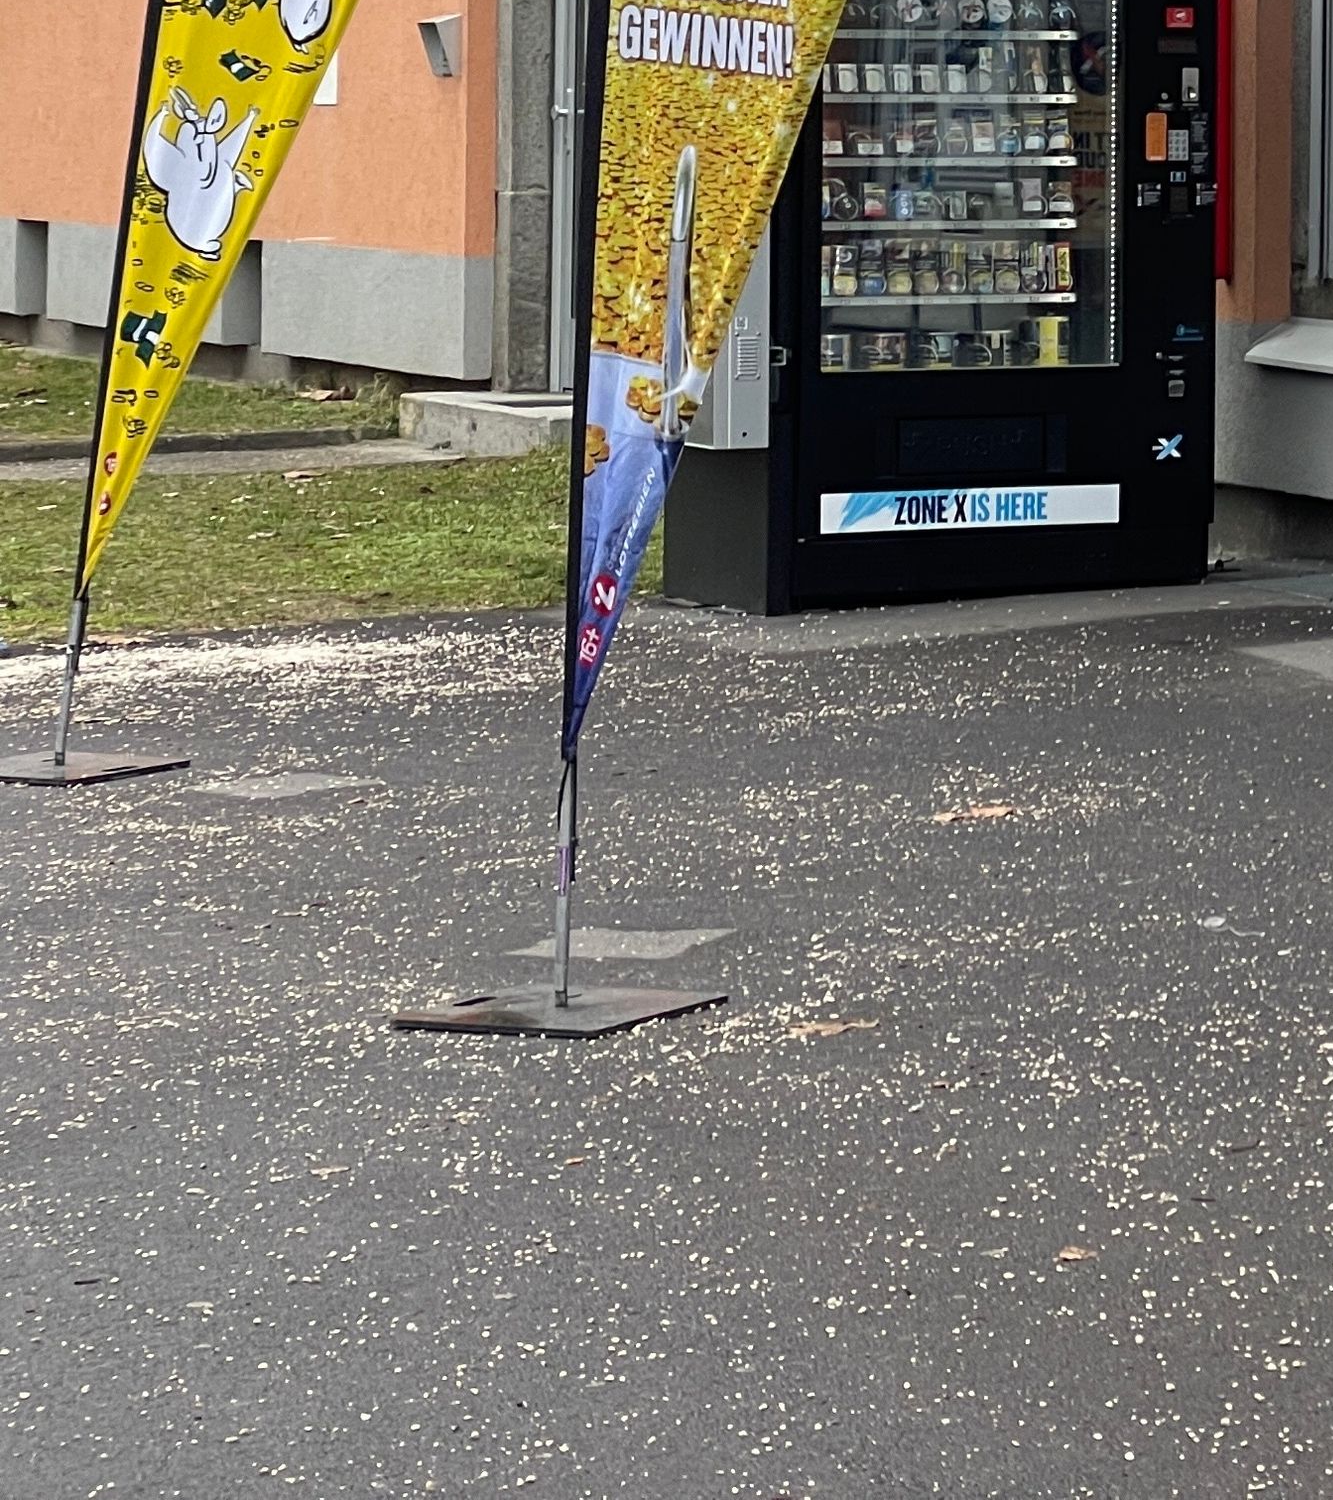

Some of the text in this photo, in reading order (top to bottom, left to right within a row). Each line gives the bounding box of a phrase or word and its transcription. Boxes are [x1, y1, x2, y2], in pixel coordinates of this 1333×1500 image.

[618, 7, 794, 79] GEWINNEN!
[615, 466, 656, 578] LOTTERIEN
[894, 491, 1049, 526] ZONE X IS HERE
[578, 627, 602, 664] 16+
